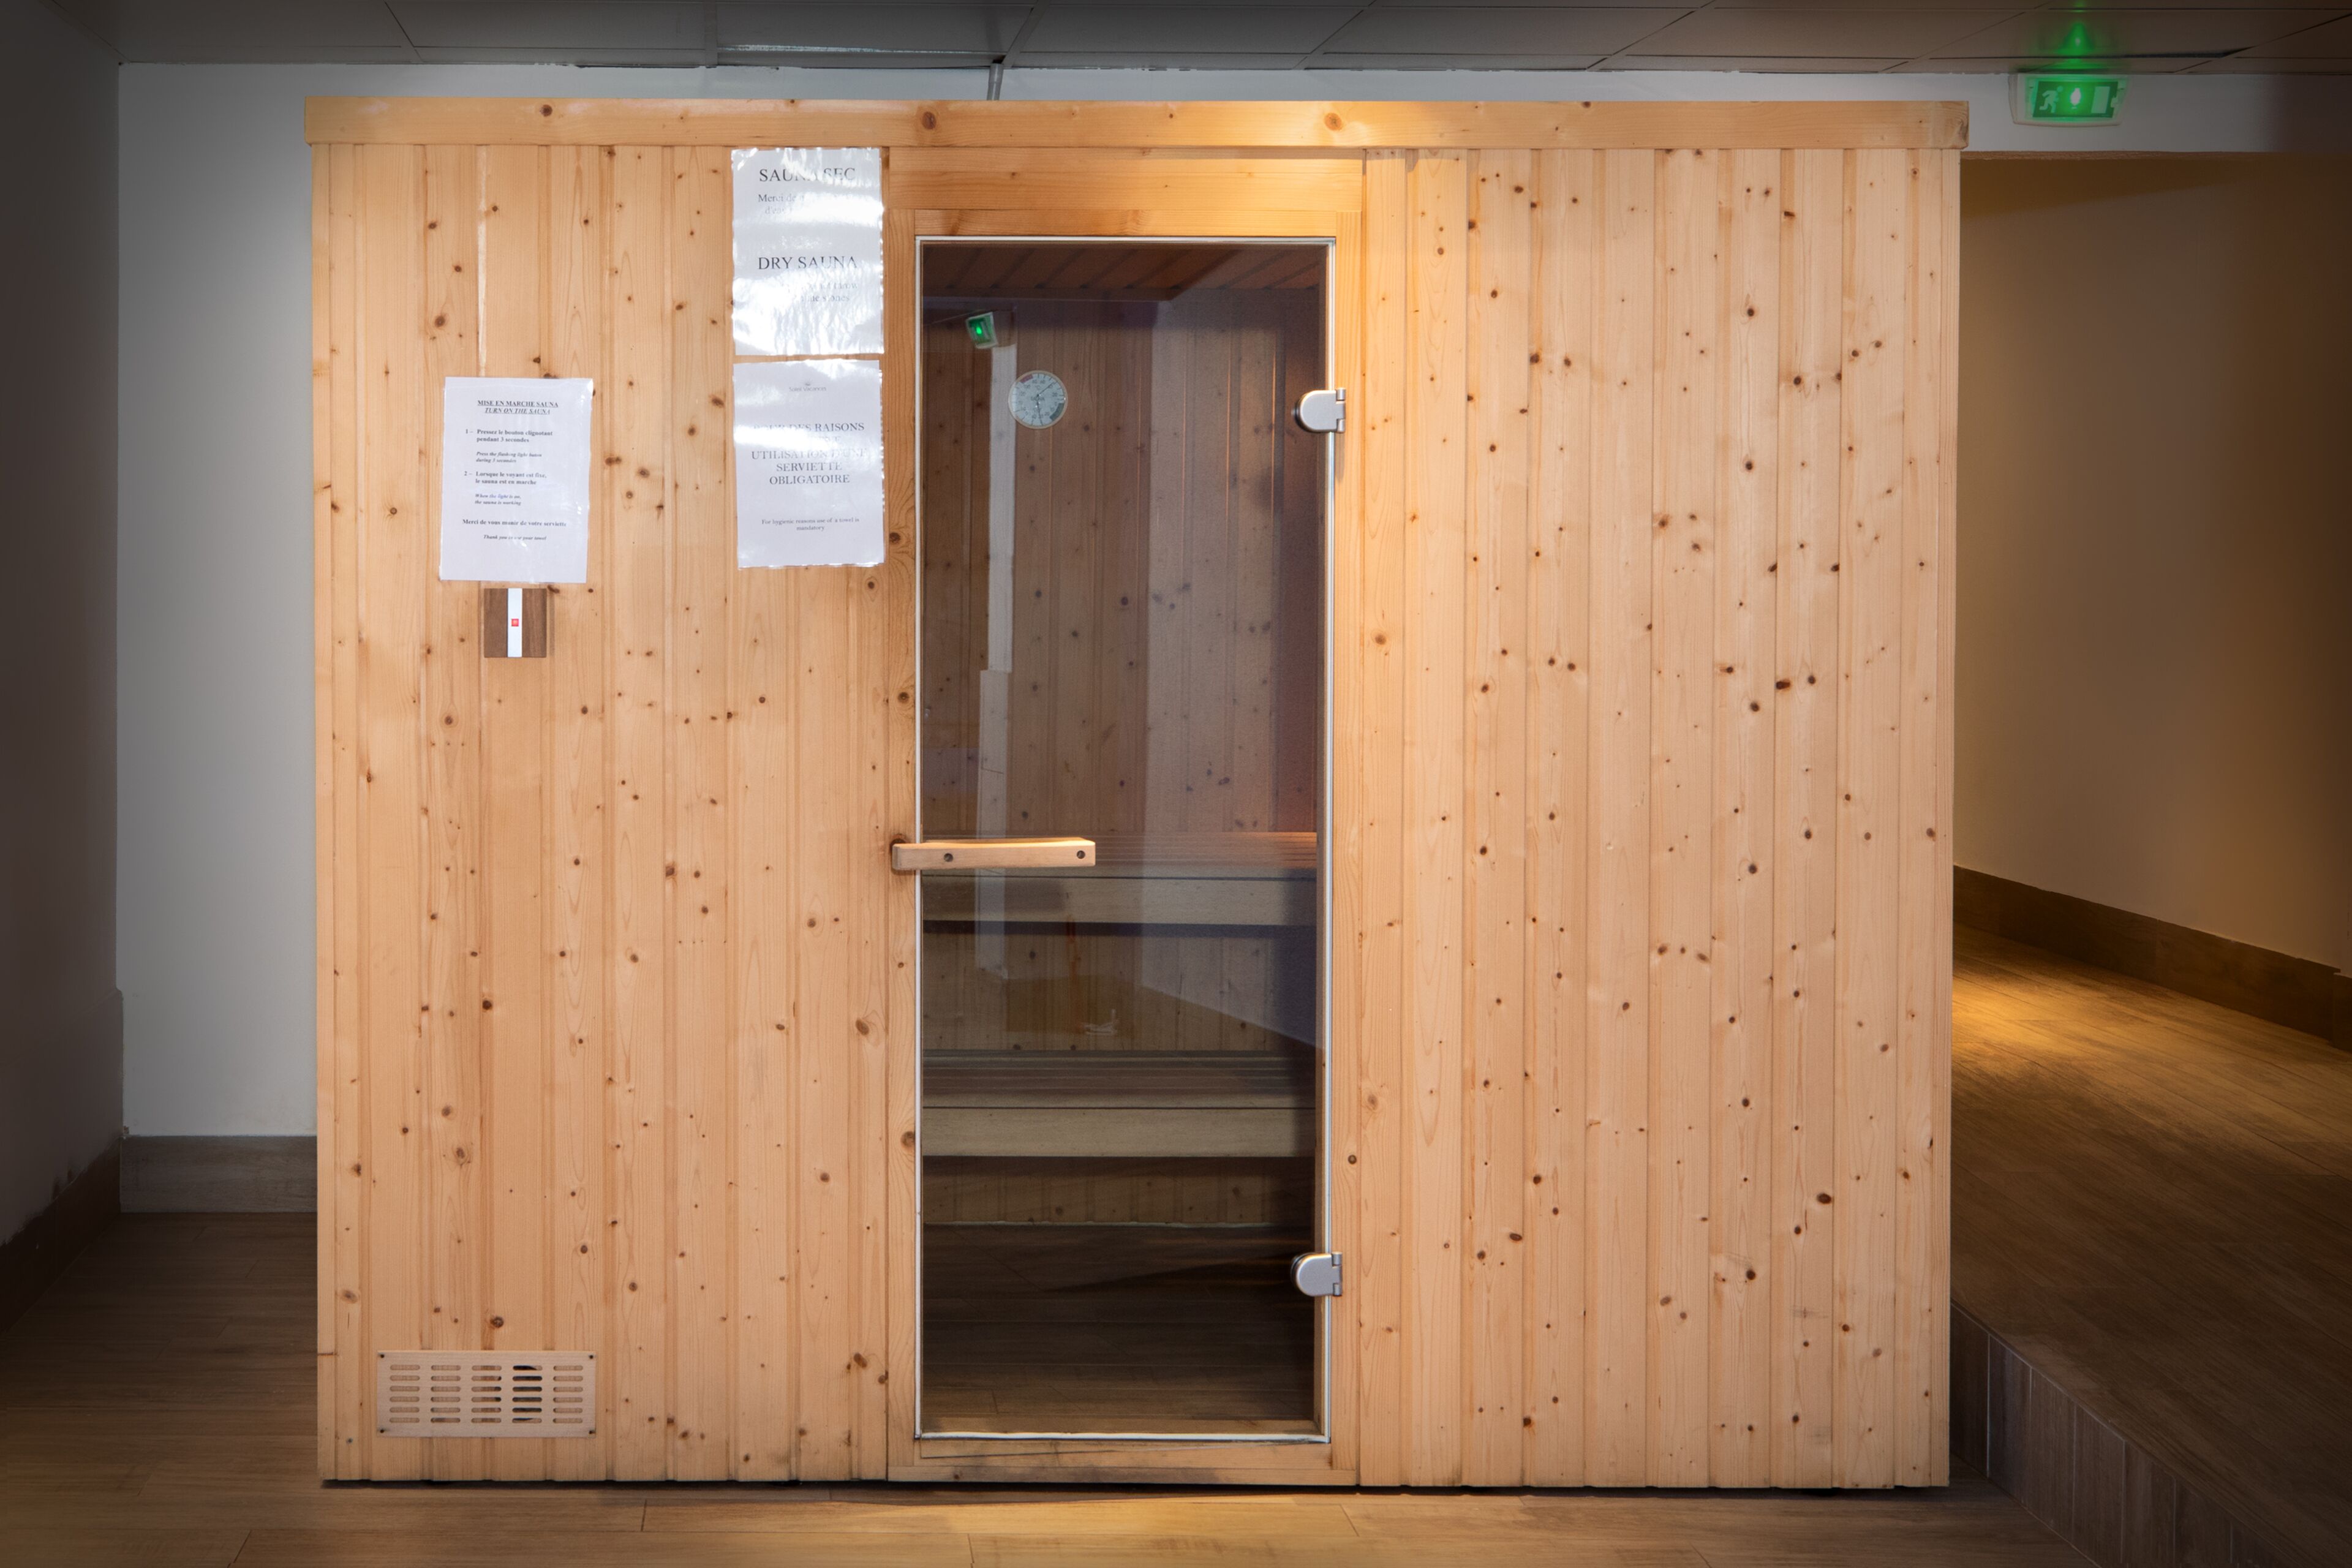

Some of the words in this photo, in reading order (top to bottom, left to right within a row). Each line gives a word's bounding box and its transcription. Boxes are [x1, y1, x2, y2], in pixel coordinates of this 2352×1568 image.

[758, 194, 783, 203] Merci
[758, 256, 793, 270] DRY
[798, 255, 858, 270] SAUNA
[815, 422, 865, 432] RAISONS
[751, 449, 827, 460] UTILISATION
[776, 462, 842, 472] SERVIETTE
[769, 474, 850, 485] OBLIGATOIRE
[772, 518, 794, 527] hygienic
